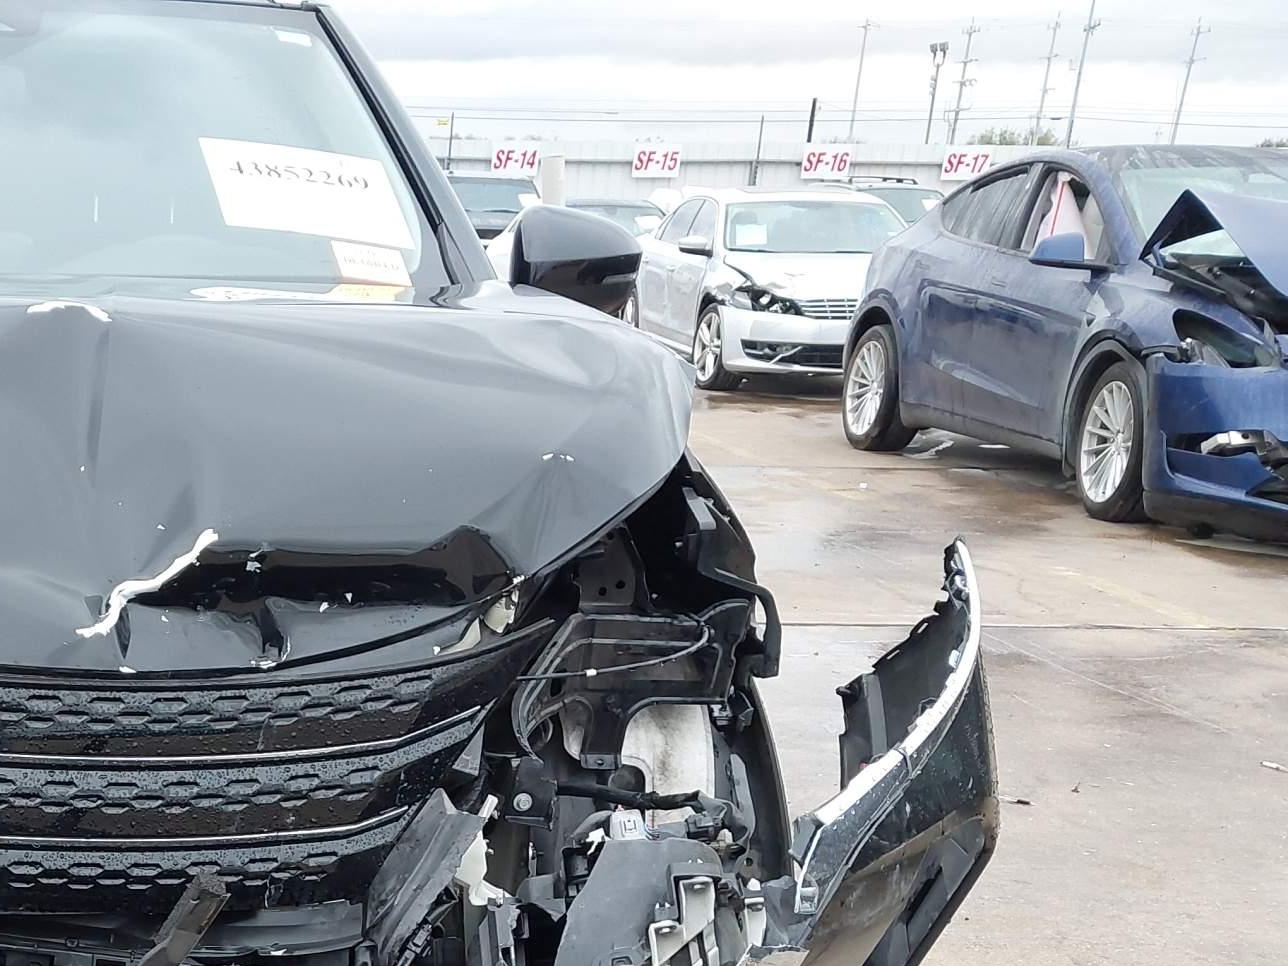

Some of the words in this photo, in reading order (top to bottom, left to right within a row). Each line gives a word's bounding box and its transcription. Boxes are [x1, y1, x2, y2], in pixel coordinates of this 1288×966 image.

[493, 149, 539, 170] SF-14
[634, 150, 679, 171] SF-15
[803, 151, 850, 172] SF-16
[943, 152, 990, 174] SF-17
[229, 159, 369, 190] 43852269
